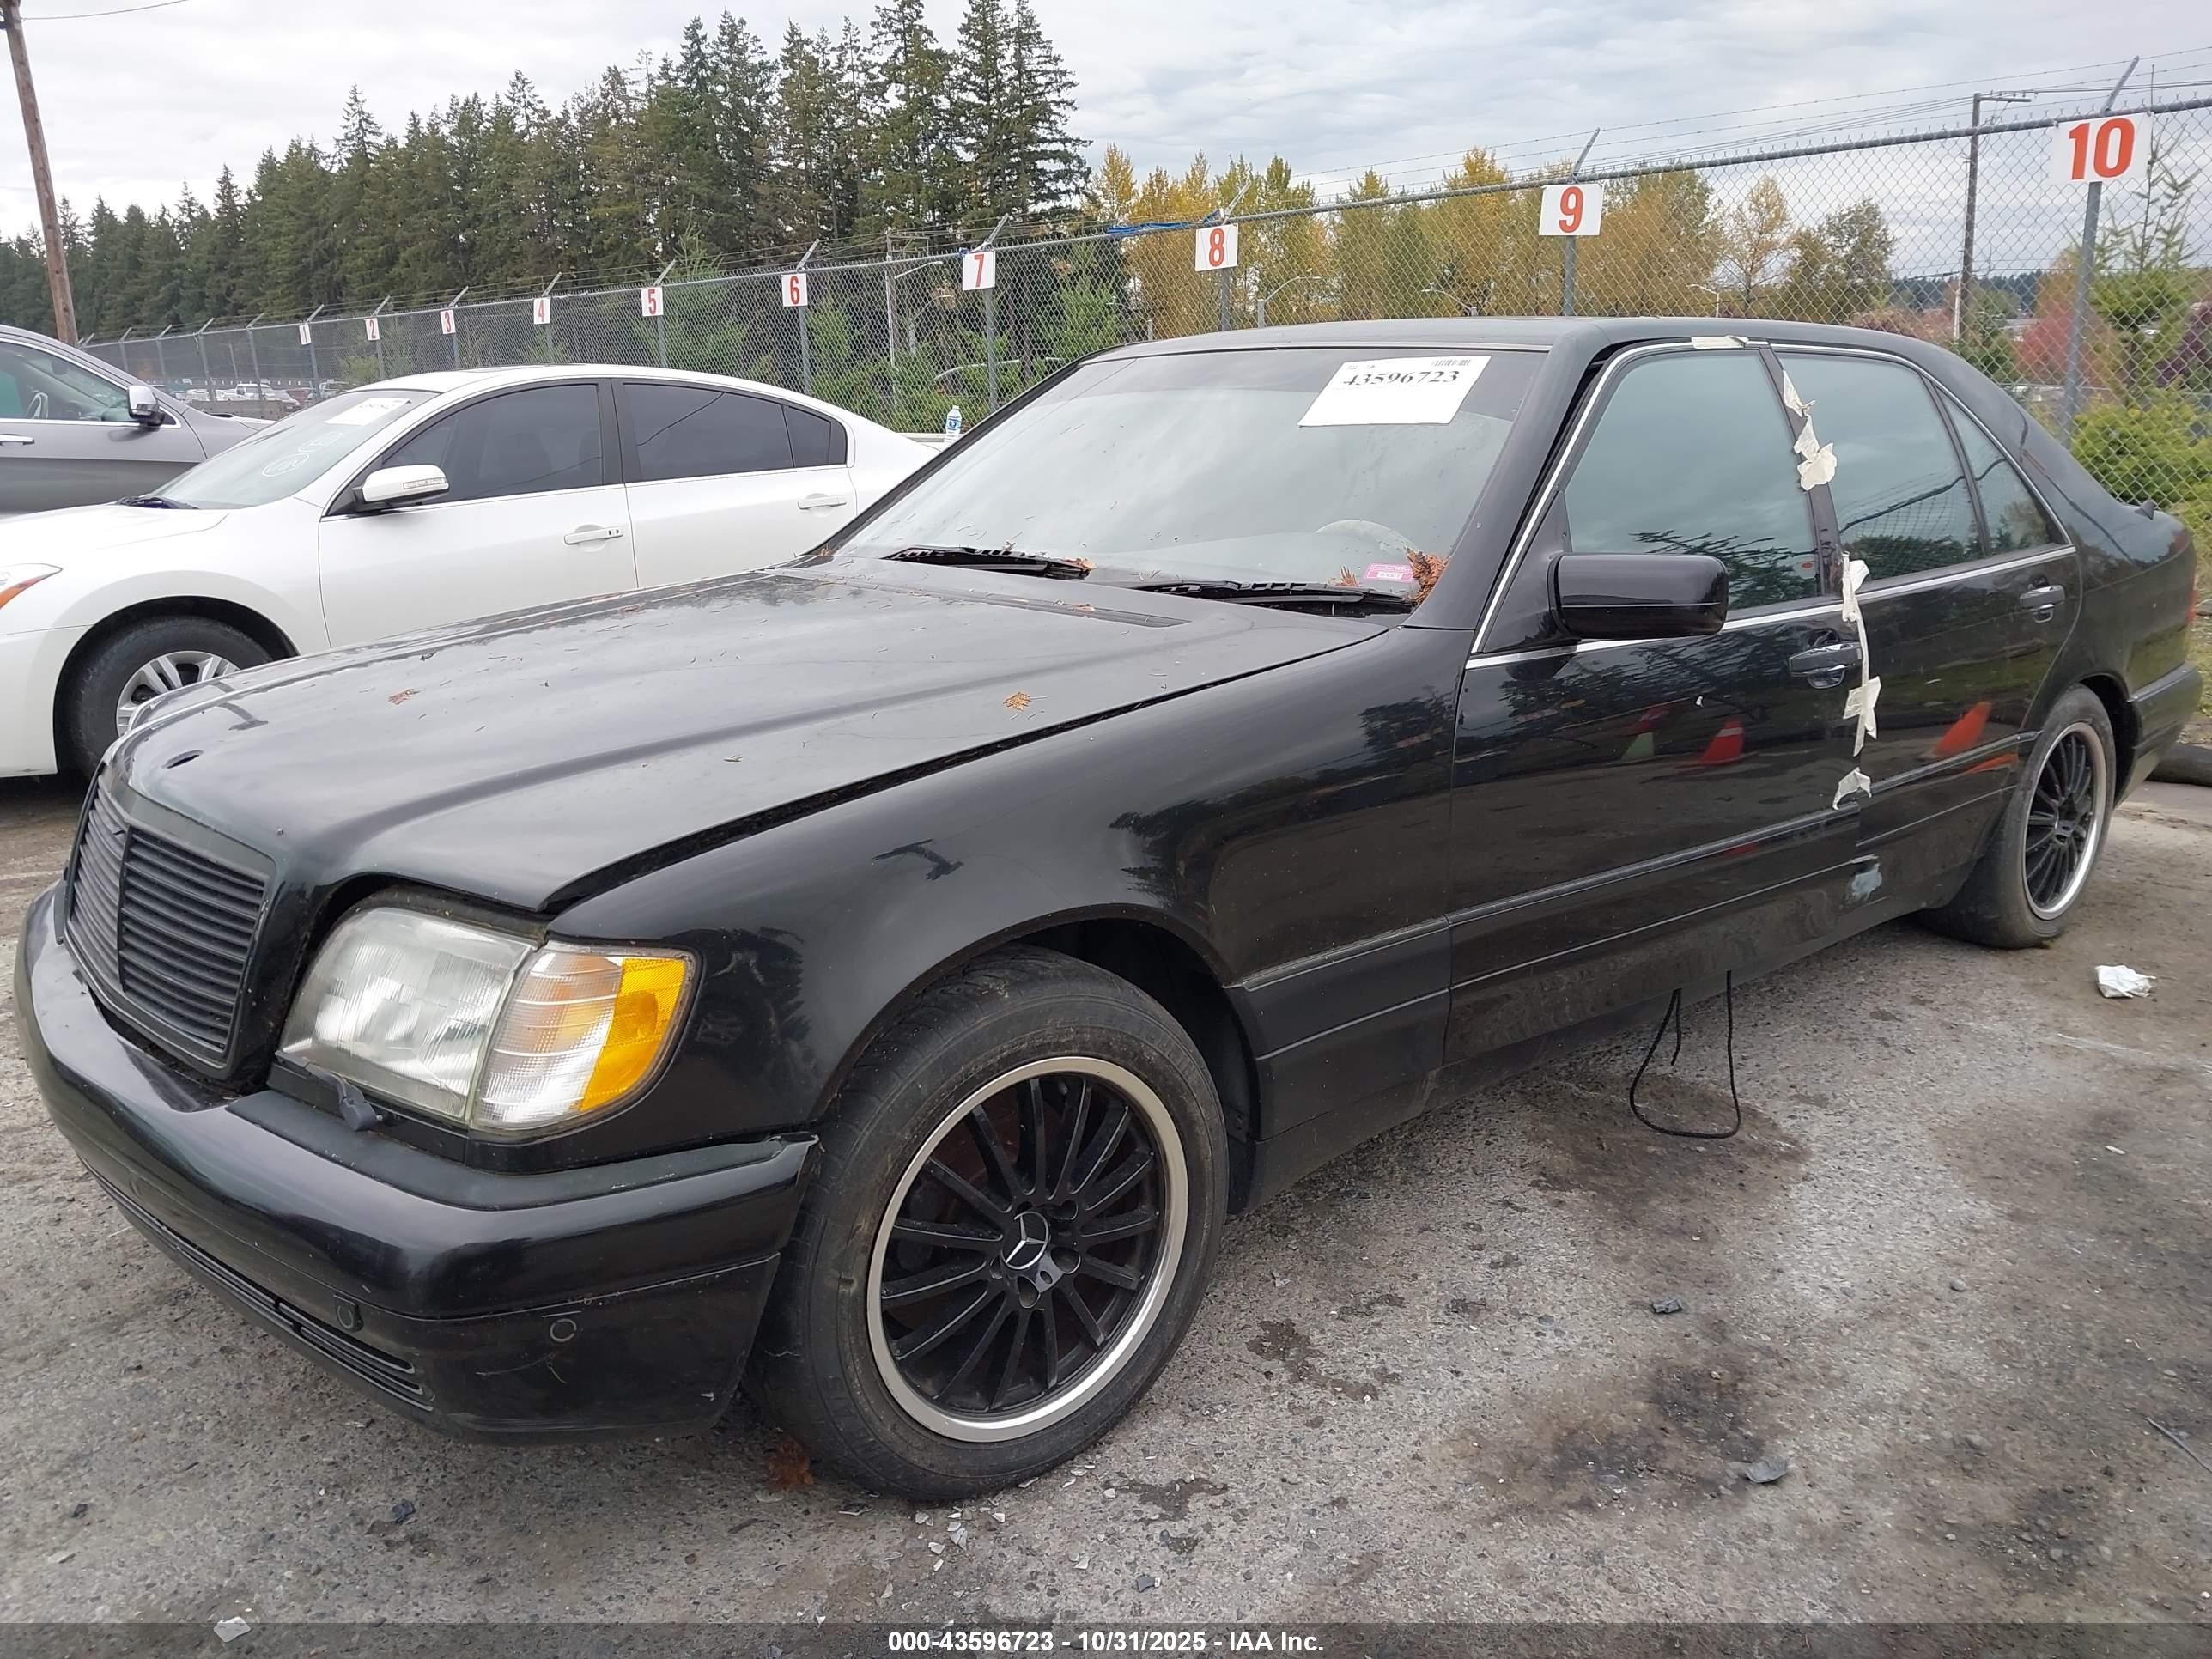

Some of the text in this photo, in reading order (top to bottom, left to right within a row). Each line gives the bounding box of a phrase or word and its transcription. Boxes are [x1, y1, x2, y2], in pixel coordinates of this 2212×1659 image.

[2069, 118, 2136, 180] 10
[1559, 186, 1584, 234] 9
[1208, 228, 1225, 267] 8
[974, 253, 985, 288] 7
[647, 289, 658, 315] 5
[789, 276, 800, 305] 6
[444, 311, 452, 333] 3
[538, 300, 545, 323] 4
[369, 319, 376, 339] 2
[1343, 370, 1461, 386] 43596723
